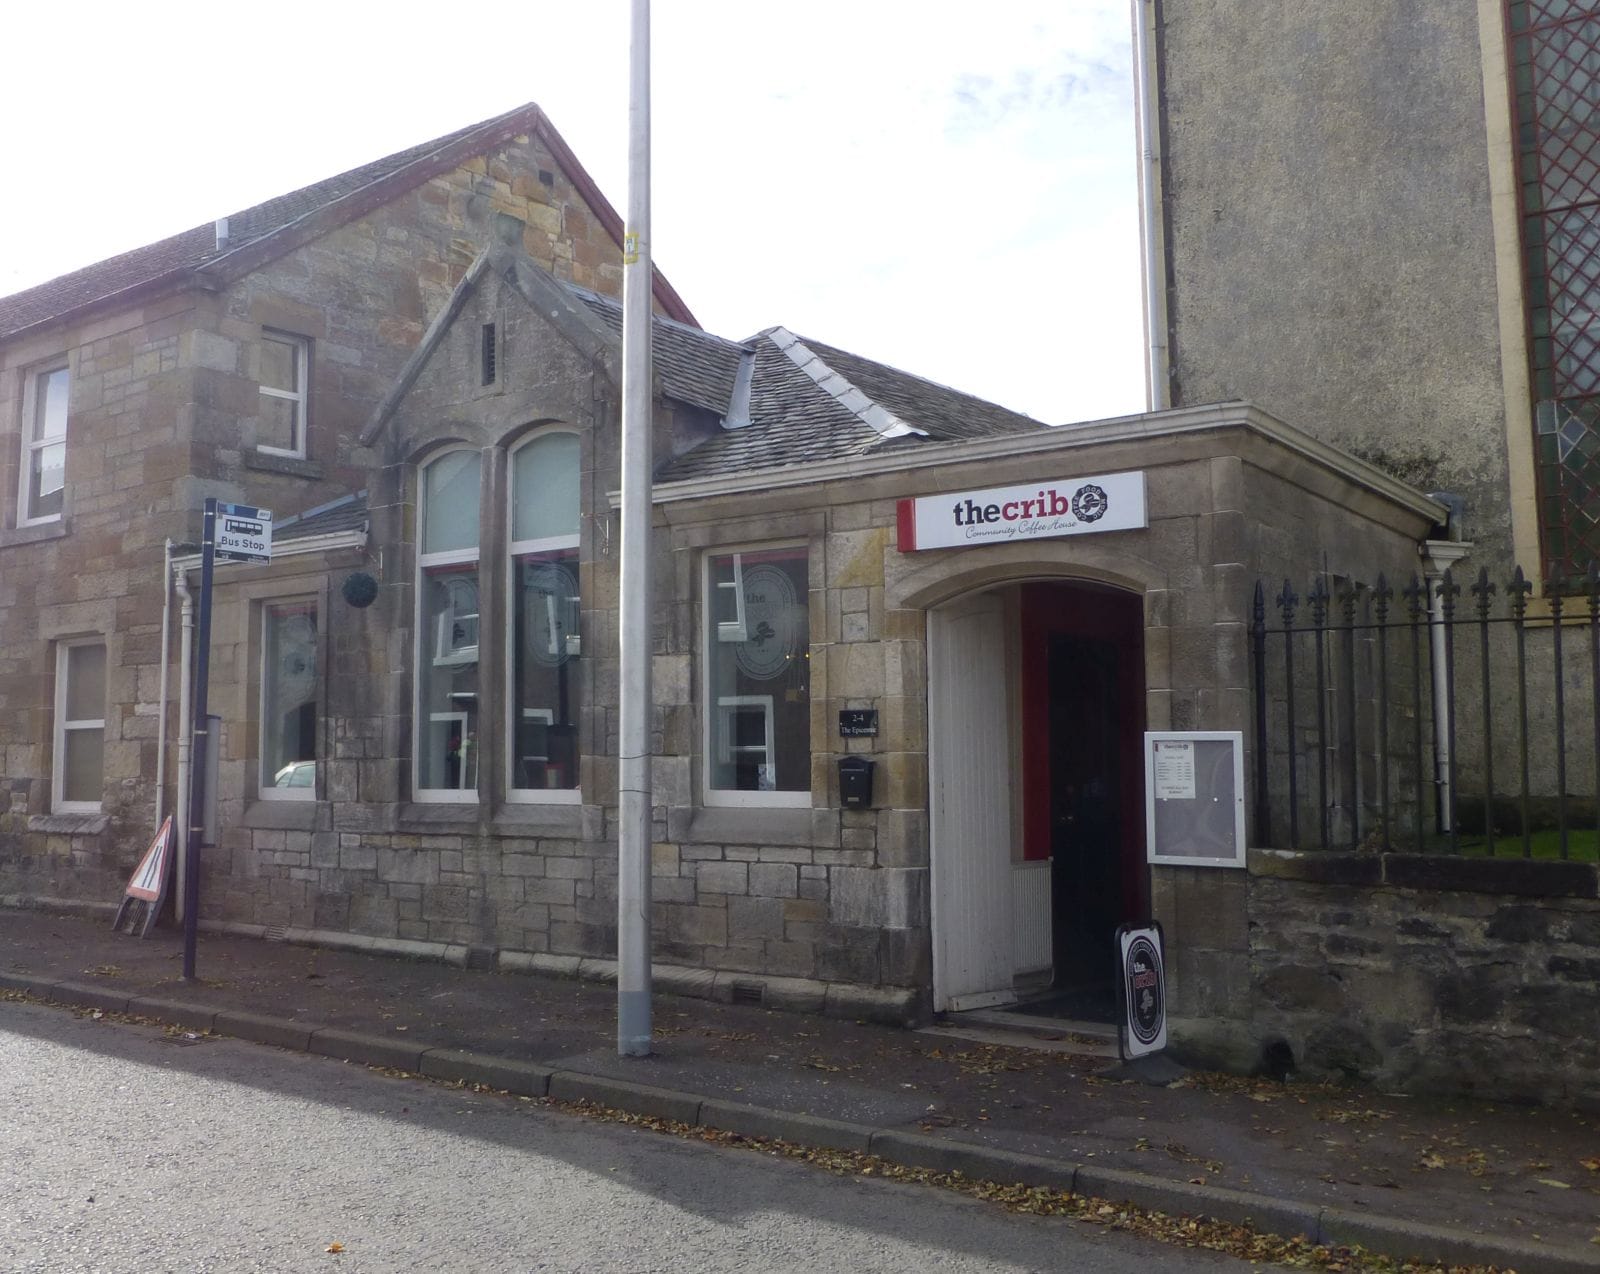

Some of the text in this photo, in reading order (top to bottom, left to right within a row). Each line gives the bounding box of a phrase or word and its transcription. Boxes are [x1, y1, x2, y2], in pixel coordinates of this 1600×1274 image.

[1073, 496, 1086, 520] COFFEE
[1081, 486, 1101, 495] FOOD
[965, 519, 1077, 538] Community Coffee House
[221, 536, 265, 551] Bus Stop
[746, 592, 766, 604] the
[851, 714, 864, 722] 2-4
[841, 726, 852, 734] The
[1134, 961, 1146, 973] the
